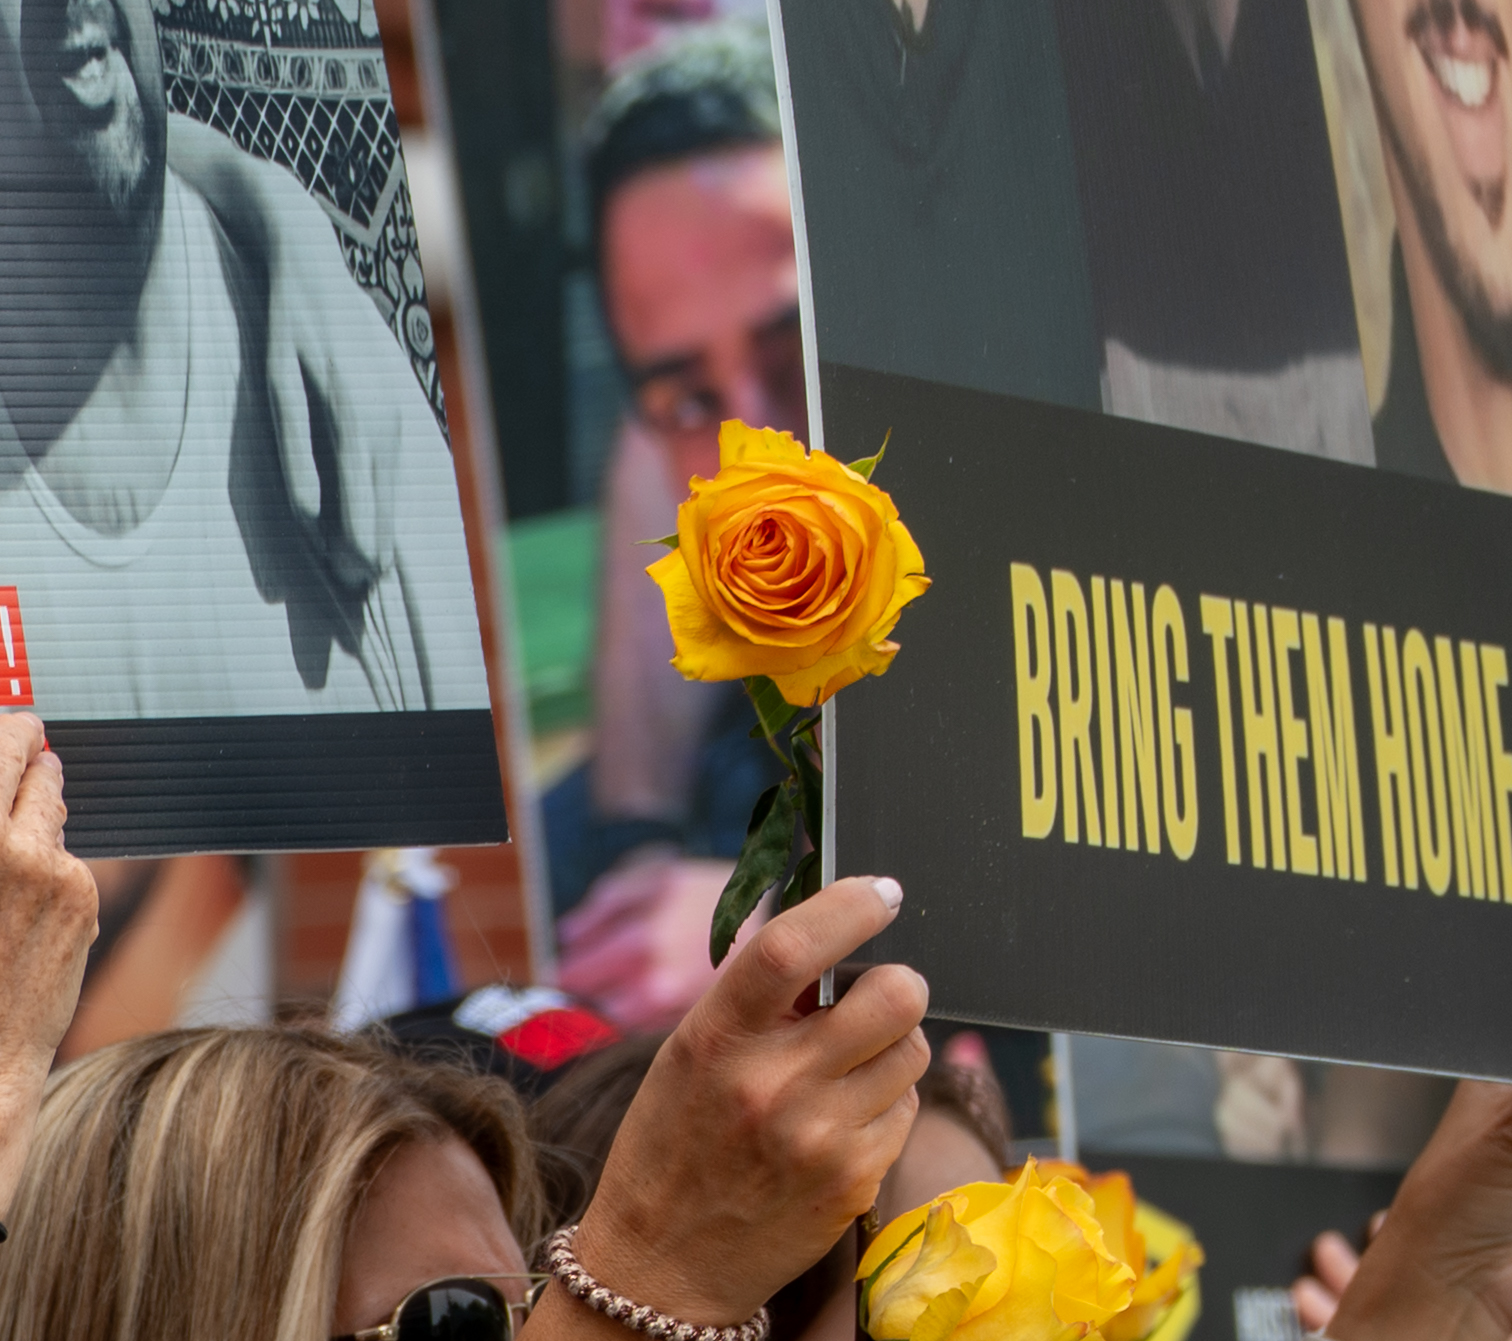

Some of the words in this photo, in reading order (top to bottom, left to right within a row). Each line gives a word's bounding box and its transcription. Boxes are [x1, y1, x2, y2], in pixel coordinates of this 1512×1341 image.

[1010, 561, 1199, 861] BRING
[1200, 593, 1367, 883] THEM
[1363, 622, 1512, 905] HOME
